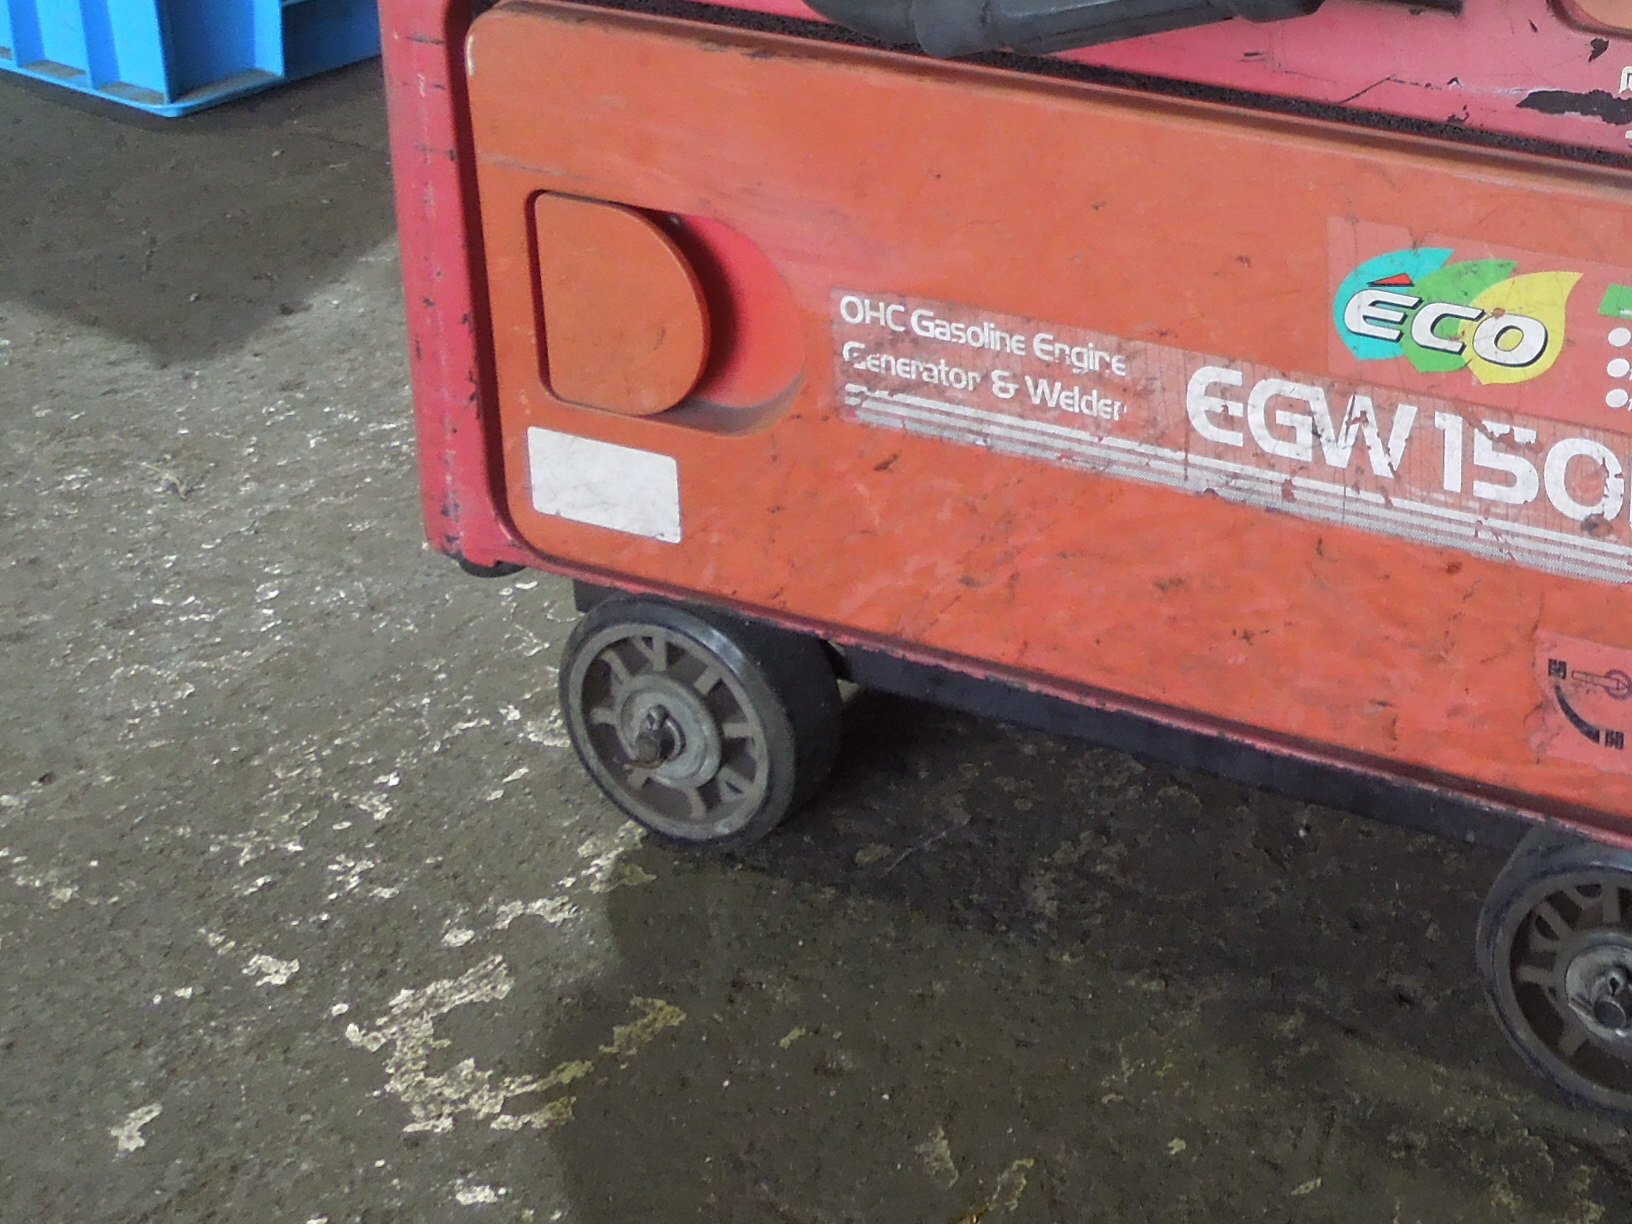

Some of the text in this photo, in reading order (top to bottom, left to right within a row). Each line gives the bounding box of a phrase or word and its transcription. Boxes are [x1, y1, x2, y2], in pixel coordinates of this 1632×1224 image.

[840, 296, 1127, 376] OHC Gasoline Engine
[842, 341, 1127, 421] Generator & Welder
